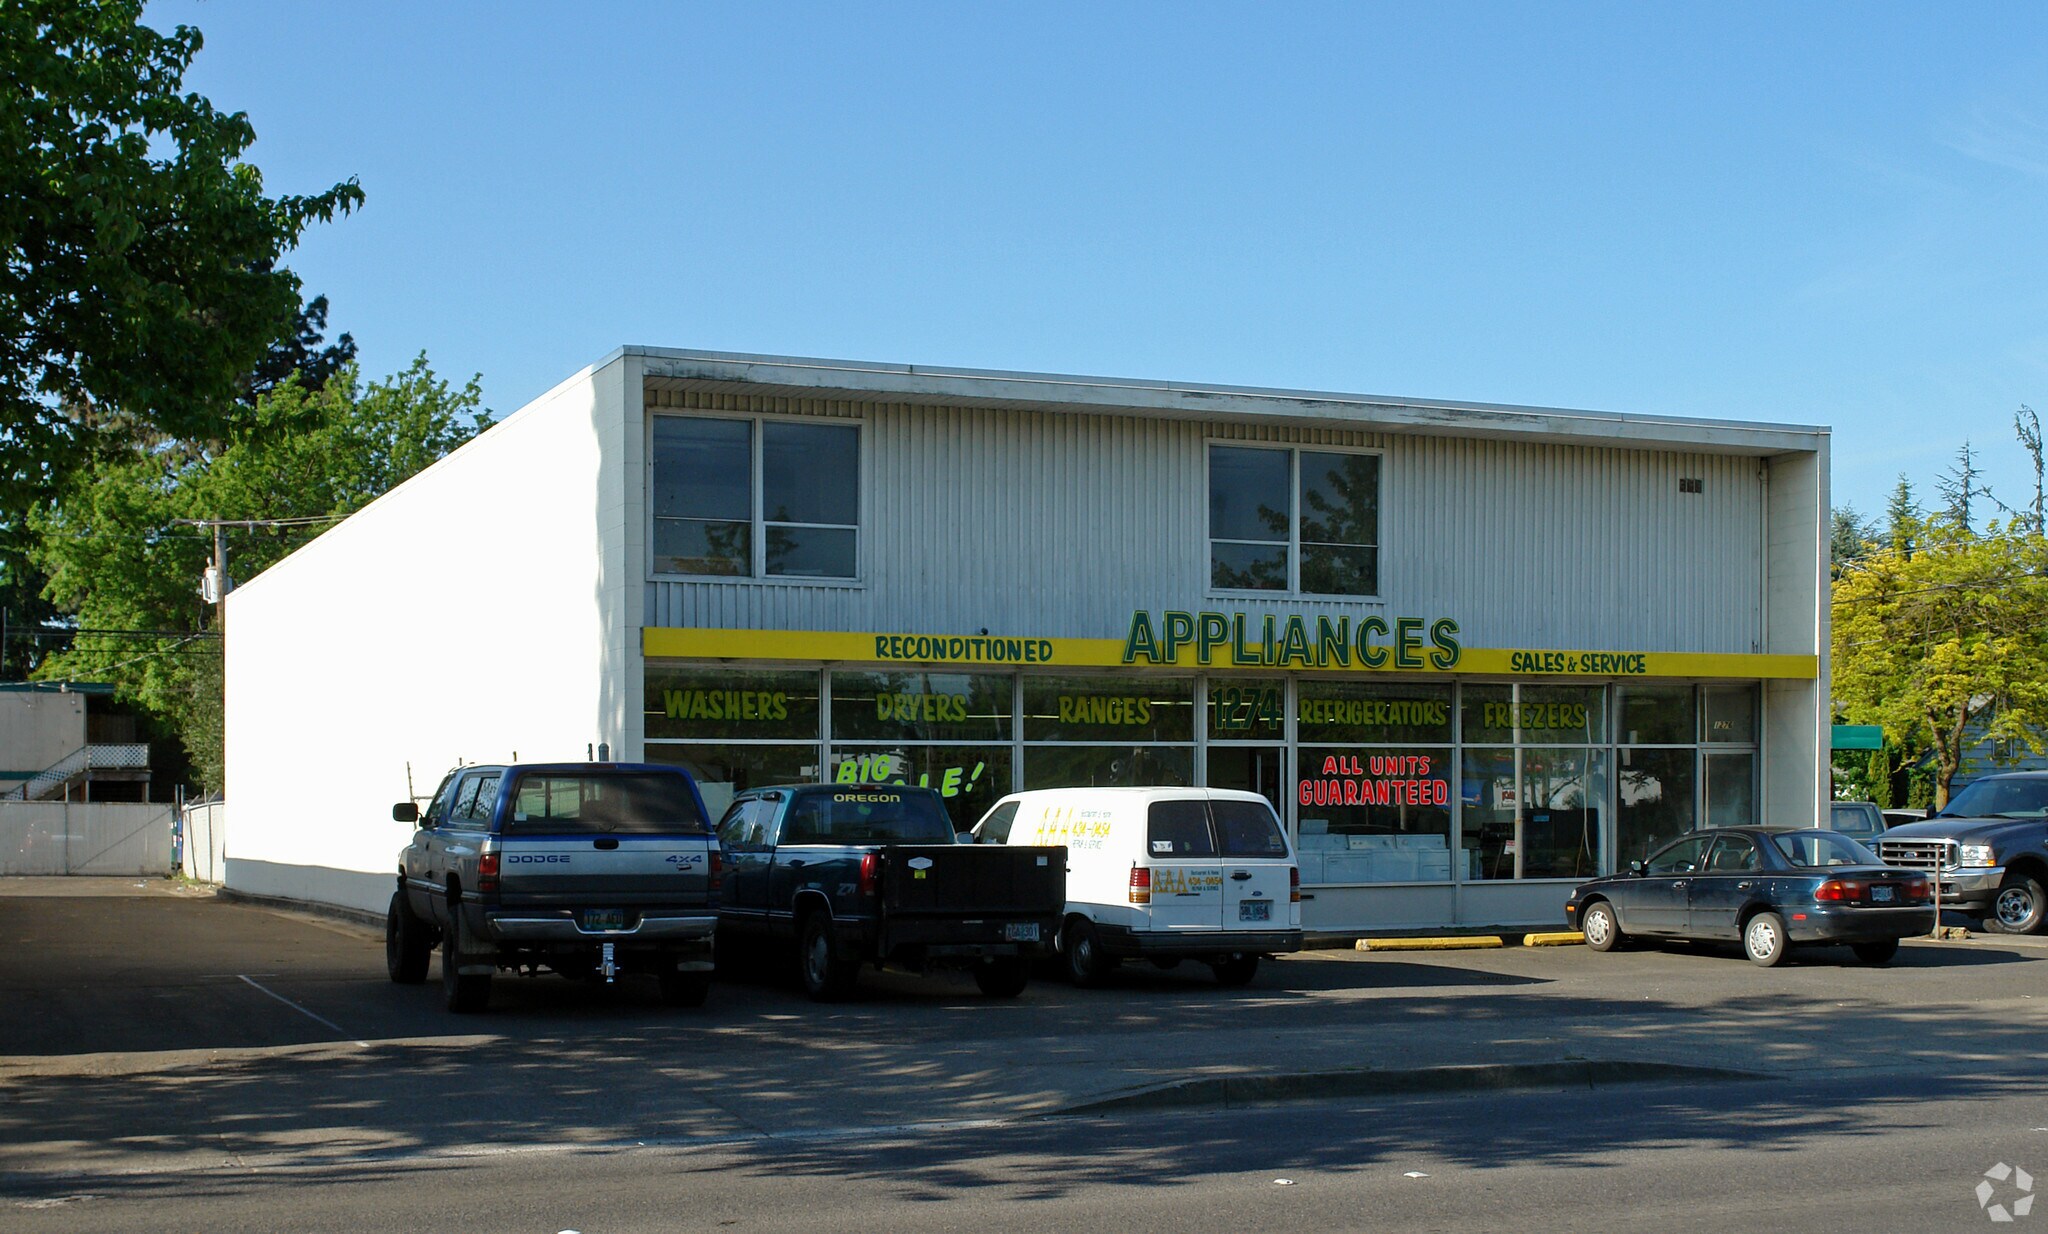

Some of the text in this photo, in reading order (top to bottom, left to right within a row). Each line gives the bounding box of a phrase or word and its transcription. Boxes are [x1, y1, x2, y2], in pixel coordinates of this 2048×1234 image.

[875, 635, 1053, 662] RECONDITIONED
[1122, 610, 1462, 670] APPLIANCES
[1511, 652, 1646, 673] SALES & SERVICE
[663, 690, 788, 721] WASHERS
[876, 692, 967, 723] DRYERS
[1058, 696, 1150, 726] RANGES
[1212, 687, 1281, 731] 1274
[1300, 699, 1447, 726] REFRIGERATORS
[1484, 702, 1587, 729] FREEZERS
[835, 754, 891, 784] BIG
[1322, 756, 1430, 776] ALL UNITS
[833, 793, 901, 803] OREGON
[1299, 779, 1448, 806] GUARANTEED
[508, 855, 571, 864] DODGE
